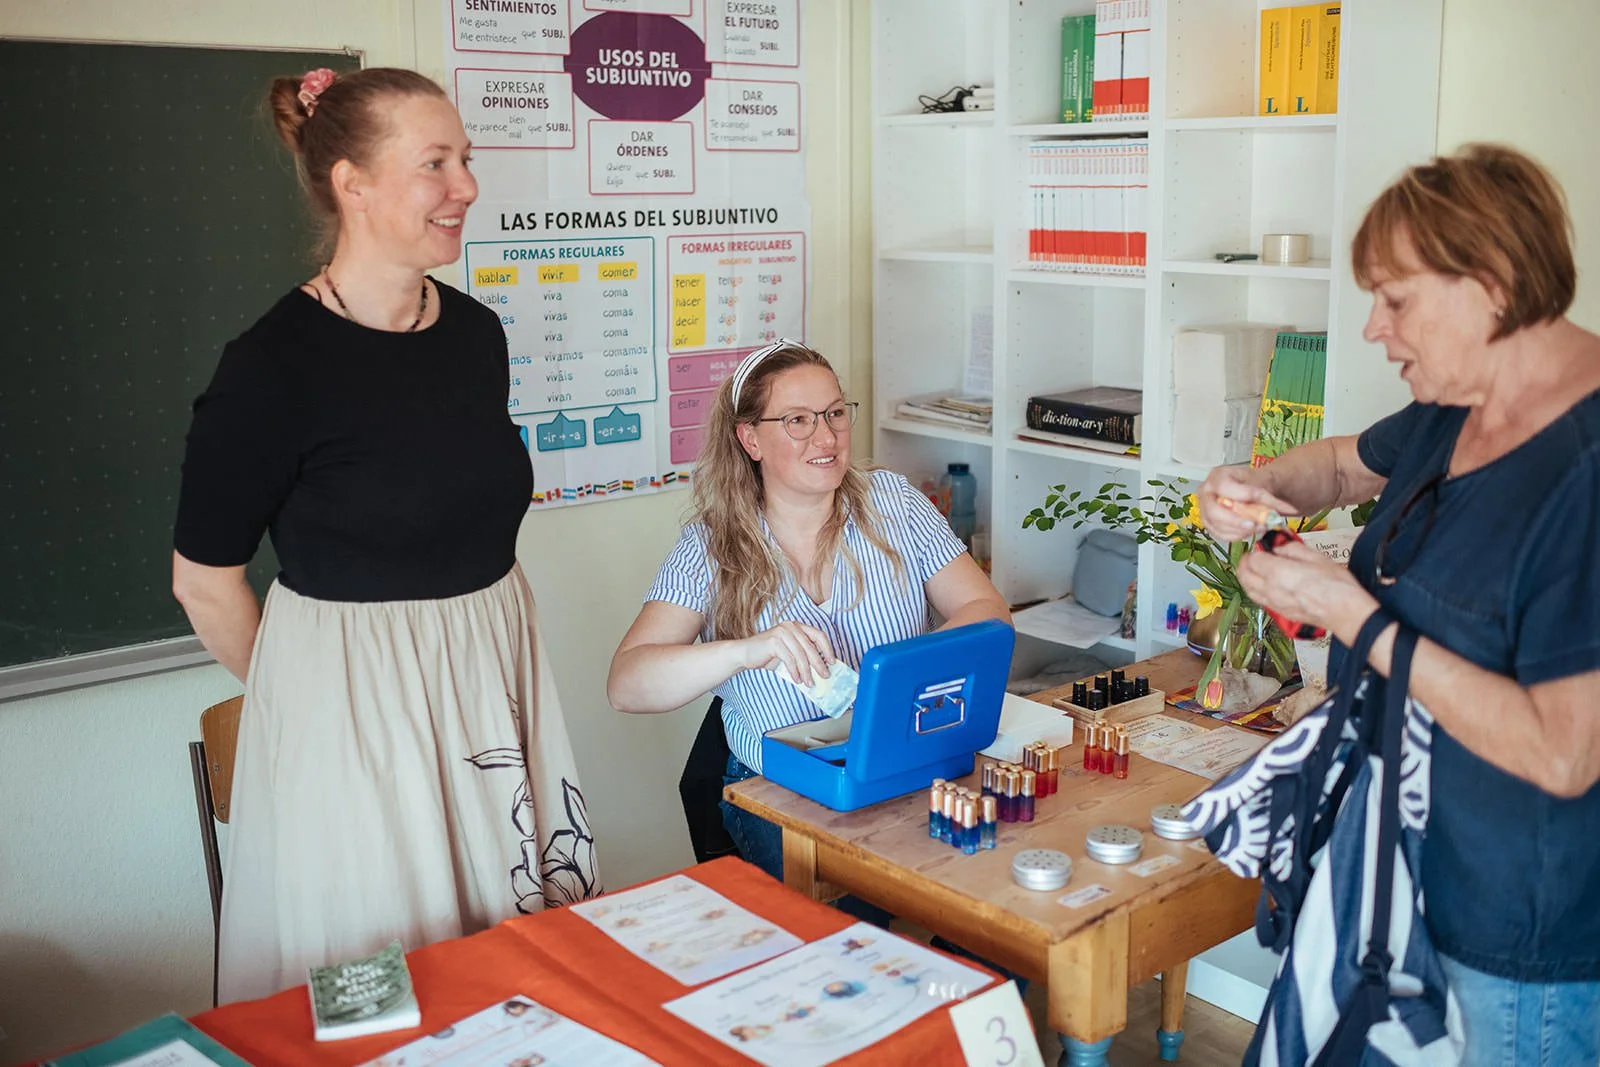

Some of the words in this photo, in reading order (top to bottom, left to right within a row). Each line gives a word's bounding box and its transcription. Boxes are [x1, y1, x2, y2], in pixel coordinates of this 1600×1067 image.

[465, 0, 557, 15] SENTIMIENTOS
[727, 2, 776, 15] EXPRESAR
[459, 17, 472, 25] Me
[474, 18, 498, 28] gusta
[725, 17, 736, 27] EL
[739, 17, 779, 30] FUTURO
[460, 32, 473, 41] Me
[475, 33, 518, 44] entristece
[521, 30, 537, 40] que
[542, 28, 566, 39] SUBJ.
[598, 49, 644, 67] USOS
[649, 51, 679, 68] DEL
[586, 66, 692, 88] SUBJUNTIVO
[485, 80, 545, 94] EXPRESAR
[742, 90, 763, 101] DAR
[482, 96, 549, 109] OPINIONES
[728, 103, 778, 115] CONSEJOS
[1265, 97, 1279, 113] L
[1295, 96, 1309, 113] L
[509, 115, 526, 124] bien
[465, 121, 478, 131] Me
[479, 123, 508, 133] parece
[528, 124, 543, 134] que
[546, 122, 571, 132] SUBJ.
[631, 131, 653, 142] DAR
[617, 143, 669, 157] ÓRDENES
[653, 169, 676, 178] SUBJ.
[500, 212, 537, 231] LAS
[545, 211, 628, 229] FORMAS
[634, 210, 667, 228] DEL
[672, 207, 779, 226] SUBJUNTIVO
[503, 248, 555, 261] FORMAS
[559, 245, 625, 259] REGULARES
[681, 242, 725, 254] FORMAS
[728, 239, 793, 252] IRREGULARES
[478, 271, 511, 284] hablar
[542, 268, 564, 280] vivir
[602, 268, 634, 278] comer
[675, 277, 701, 288] tener
[480, 292, 508, 304] hable
[543, 290, 562, 301] viva
[602, 287, 628, 298] coma
[675, 296, 701, 308] hacer
[544, 311, 568, 321] vivas
[602, 308, 633, 318] comas
[675, 316, 699, 327] decir
[544, 331, 563, 342] viva
[603, 329, 628, 338] coma
[544, 351, 584, 362] vivamos
[602, 345, 648, 357] comamos
[547, 391, 572, 402] vivan
[605, 386, 637, 397] coman
[677, 399, 700, 410] estar
[543, 431, 556, 443] -ir
[985, 1015, 1017, 1067] 3
